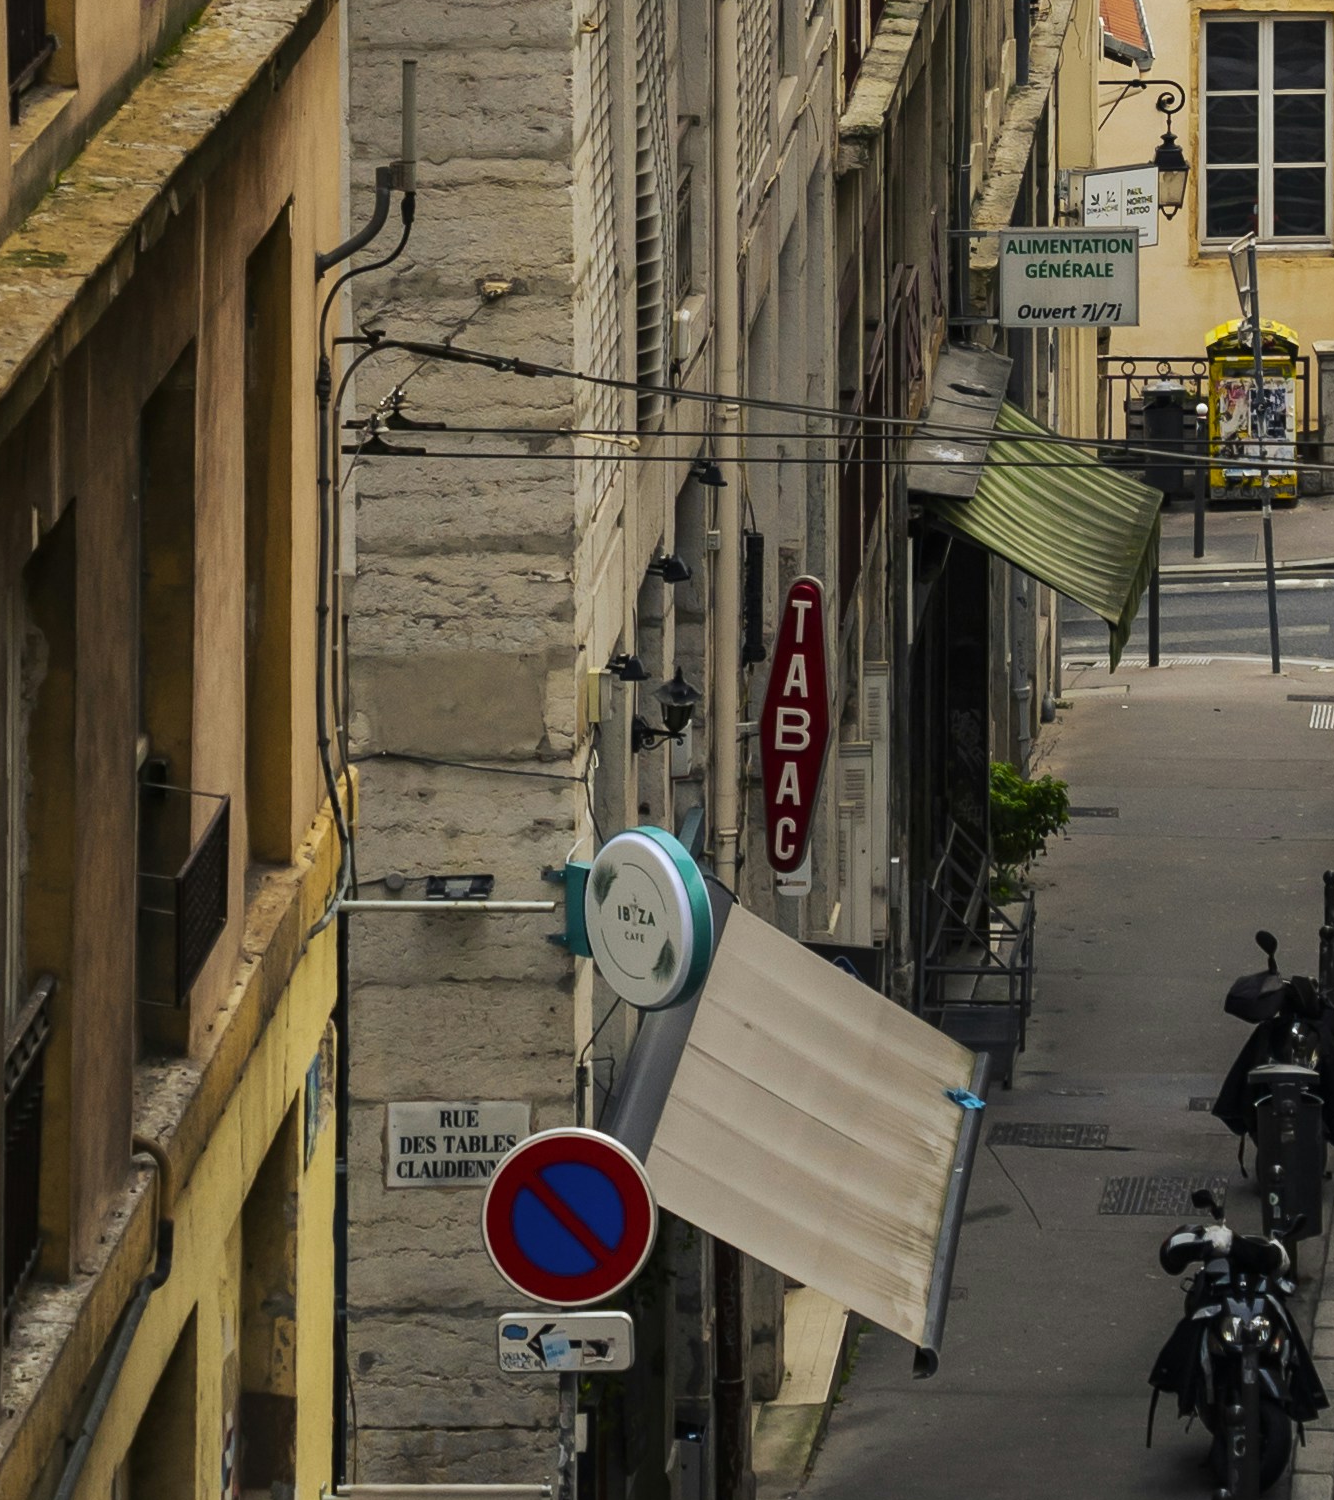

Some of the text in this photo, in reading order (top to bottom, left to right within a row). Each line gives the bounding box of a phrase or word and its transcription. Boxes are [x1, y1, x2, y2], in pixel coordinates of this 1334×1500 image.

[1126, 206, 1150, 216] TATTOO
[1005, 238, 1134, 255] ALIMENTATION
[1025, 260, 1114, 279] GÉNÉRALE
[1017, 302, 1123, 322] Ouvert 7j/7j
[774, 600, 813, 861] TABAC
[439, 1109, 479, 1129] RUE
[399, 1134, 517, 1155] DES TABLES
[396, 1159, 499, 1179] CLAUDIENN
